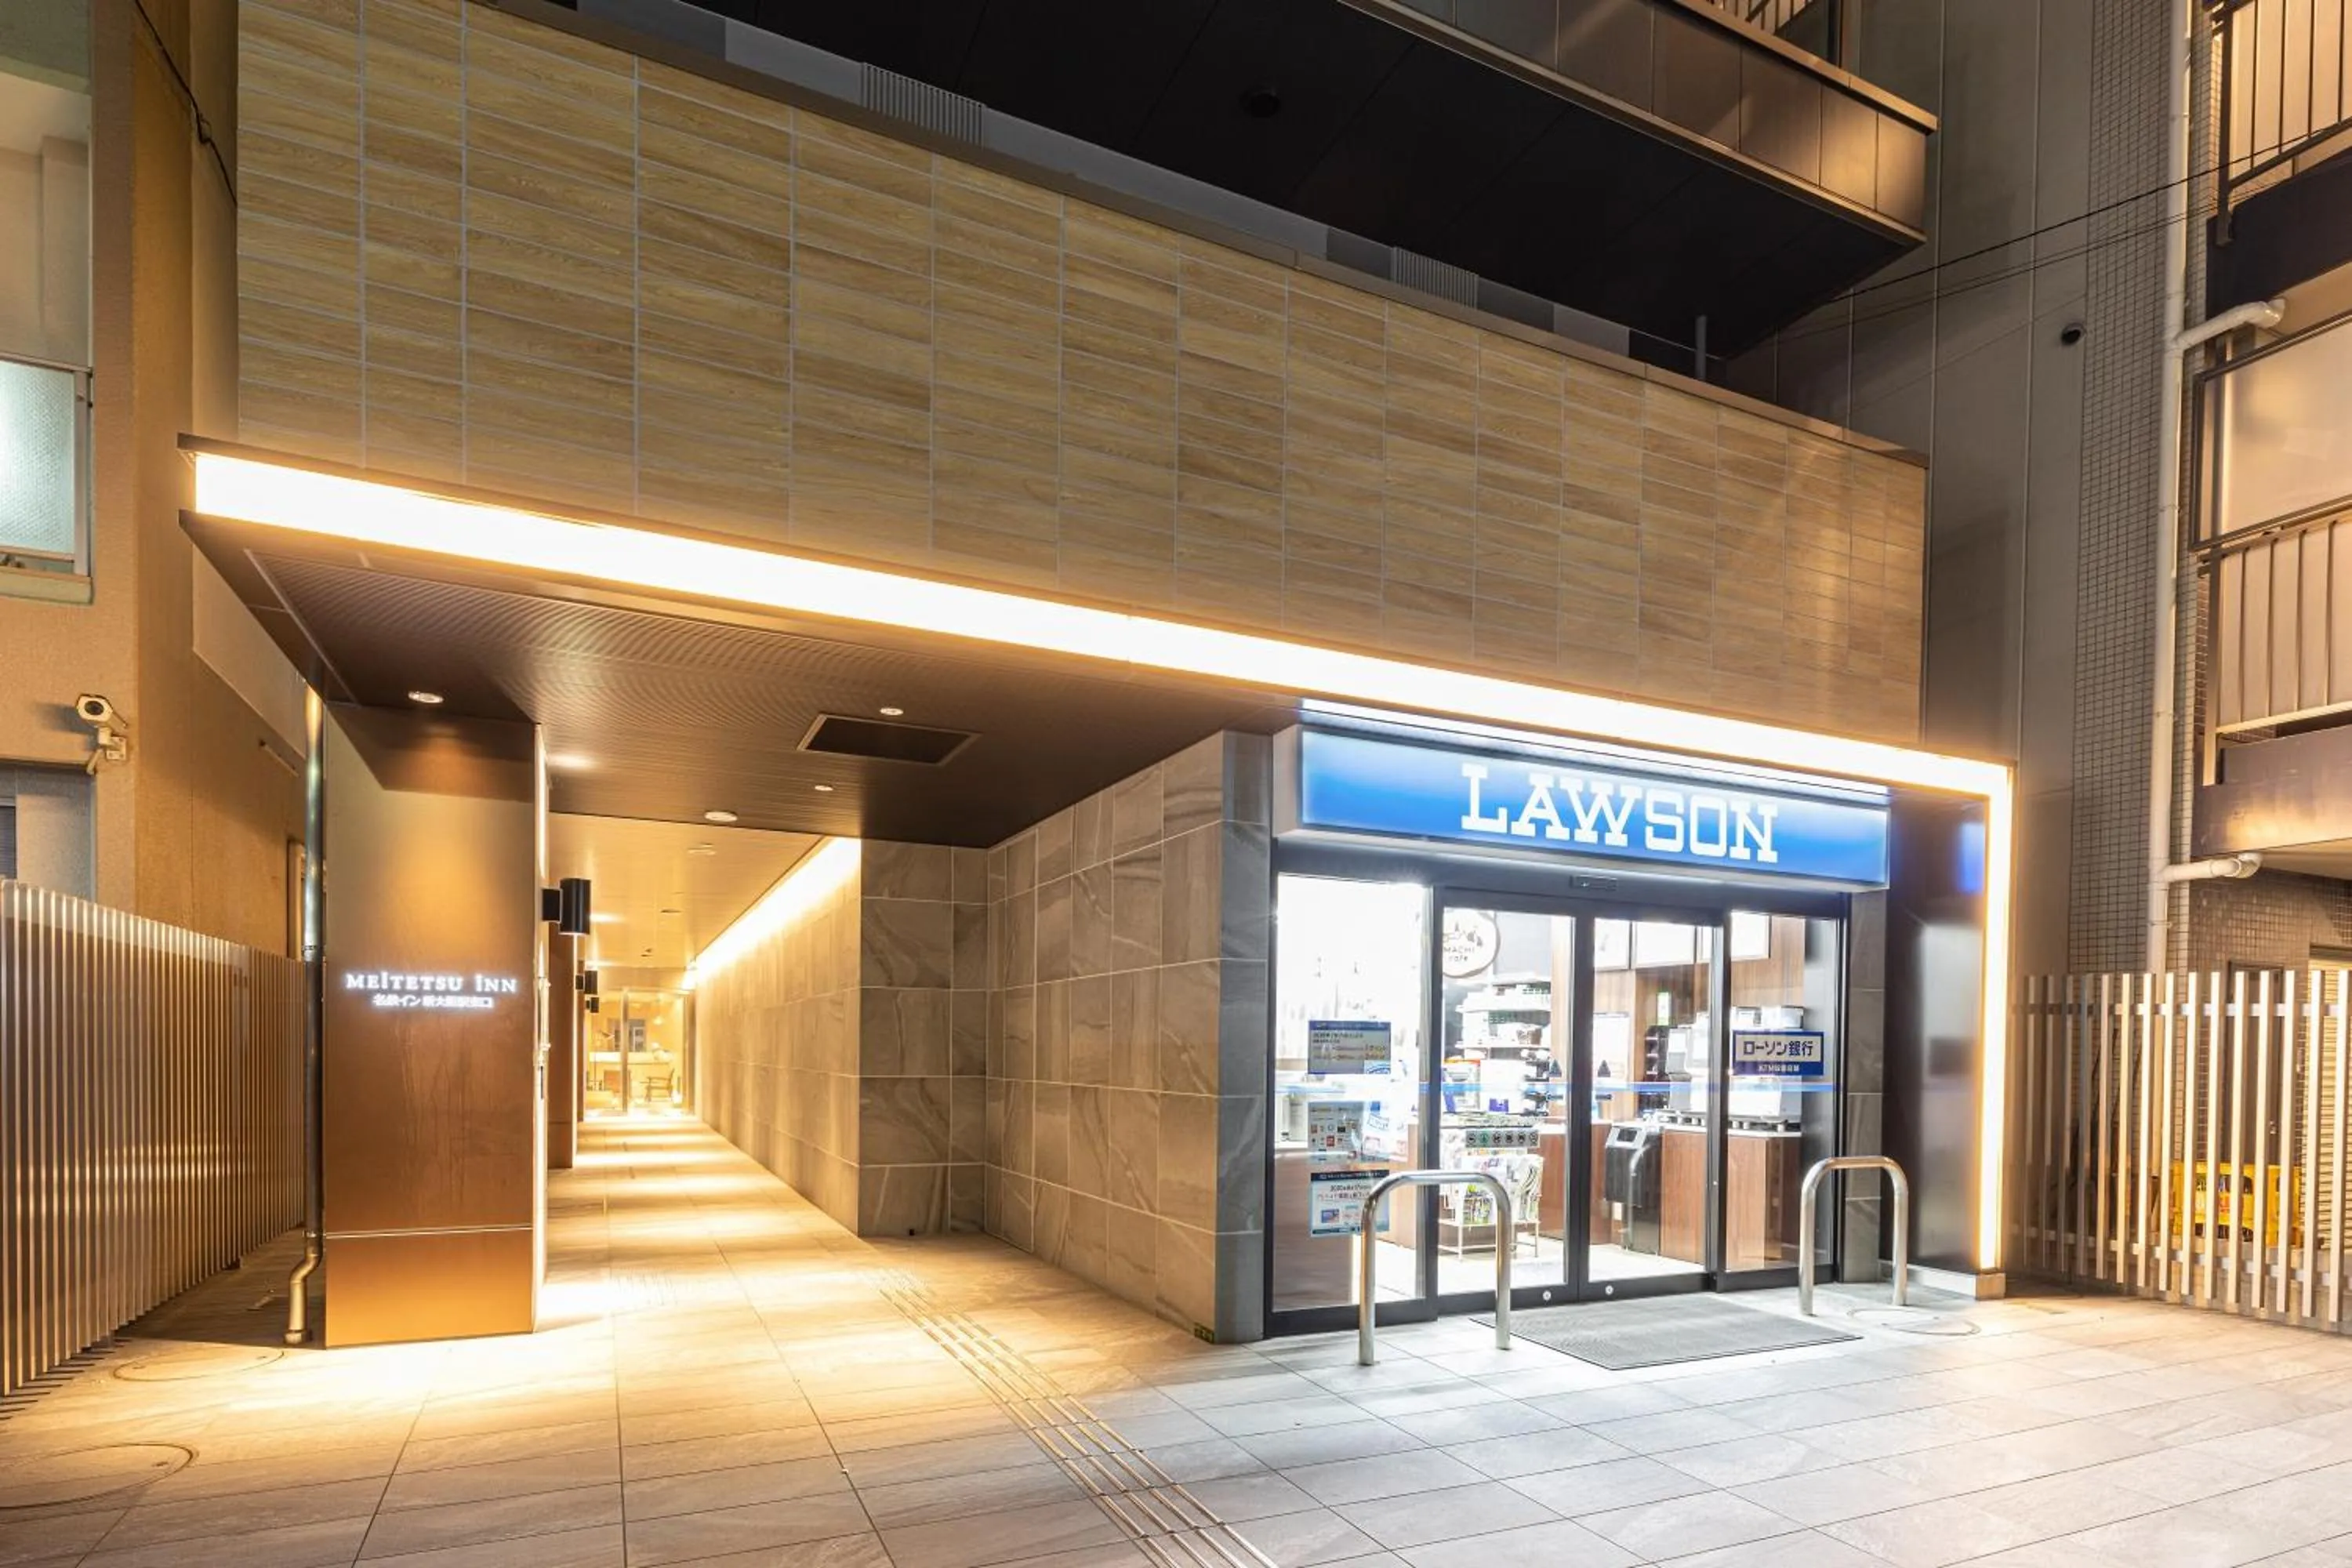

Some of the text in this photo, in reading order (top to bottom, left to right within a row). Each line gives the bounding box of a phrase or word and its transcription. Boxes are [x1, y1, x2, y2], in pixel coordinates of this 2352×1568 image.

[1461, 762, 1778, 863] LAWSON
[345, 971, 517, 993] MEITETSU INN
[1743, 1040, 1813, 1057] ローソン銀行
